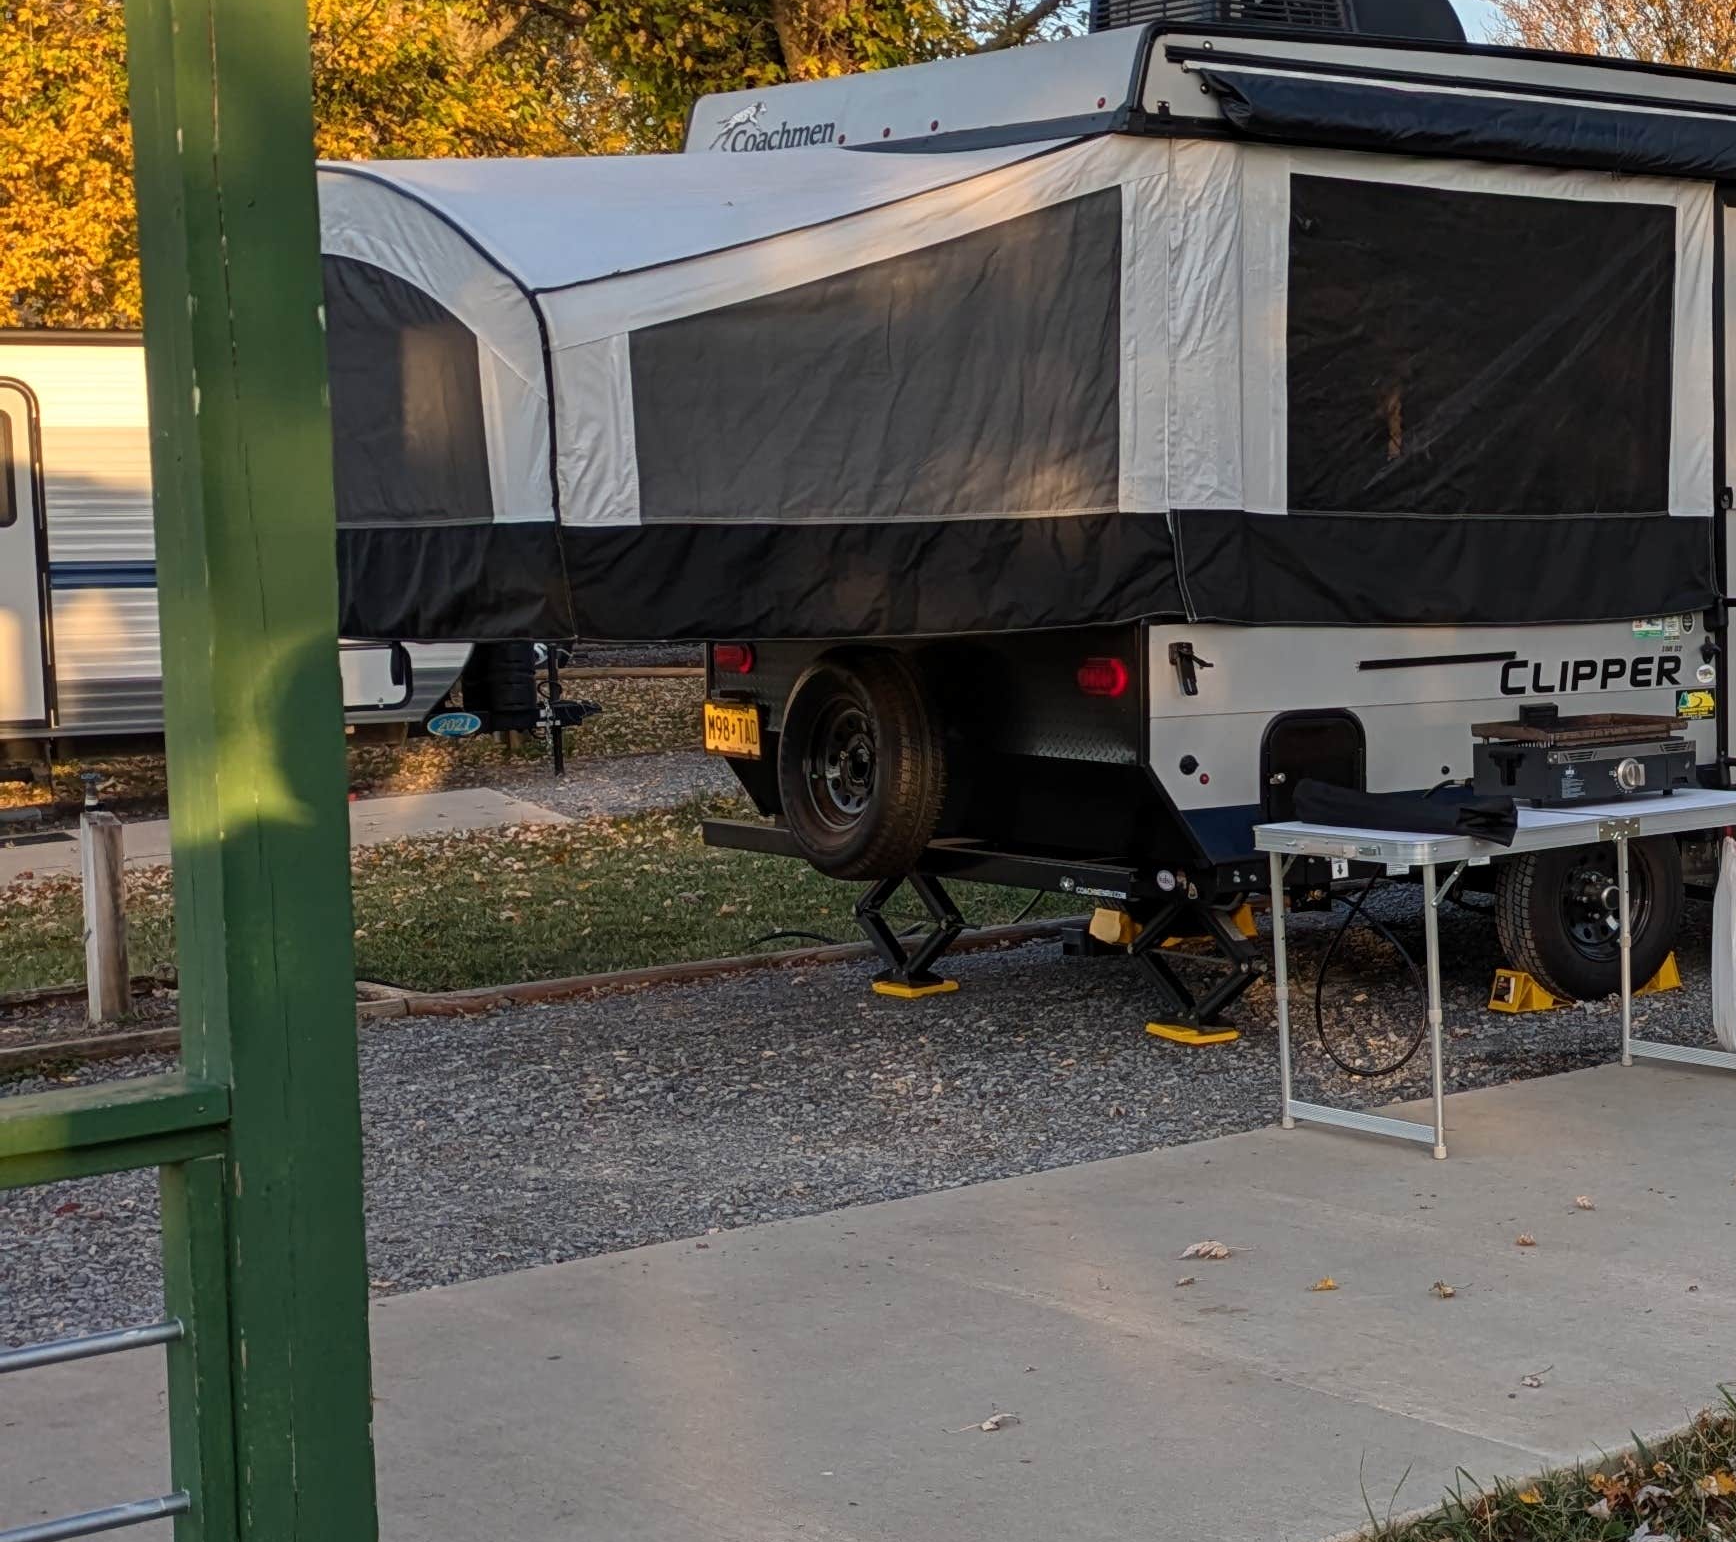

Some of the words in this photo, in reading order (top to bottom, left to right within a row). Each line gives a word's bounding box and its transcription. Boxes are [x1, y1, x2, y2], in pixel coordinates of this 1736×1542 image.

[731, 121, 835, 152] Coachmen
[1500, 654, 1682, 696] CLIPPER
[707, 714, 730, 742] M98
